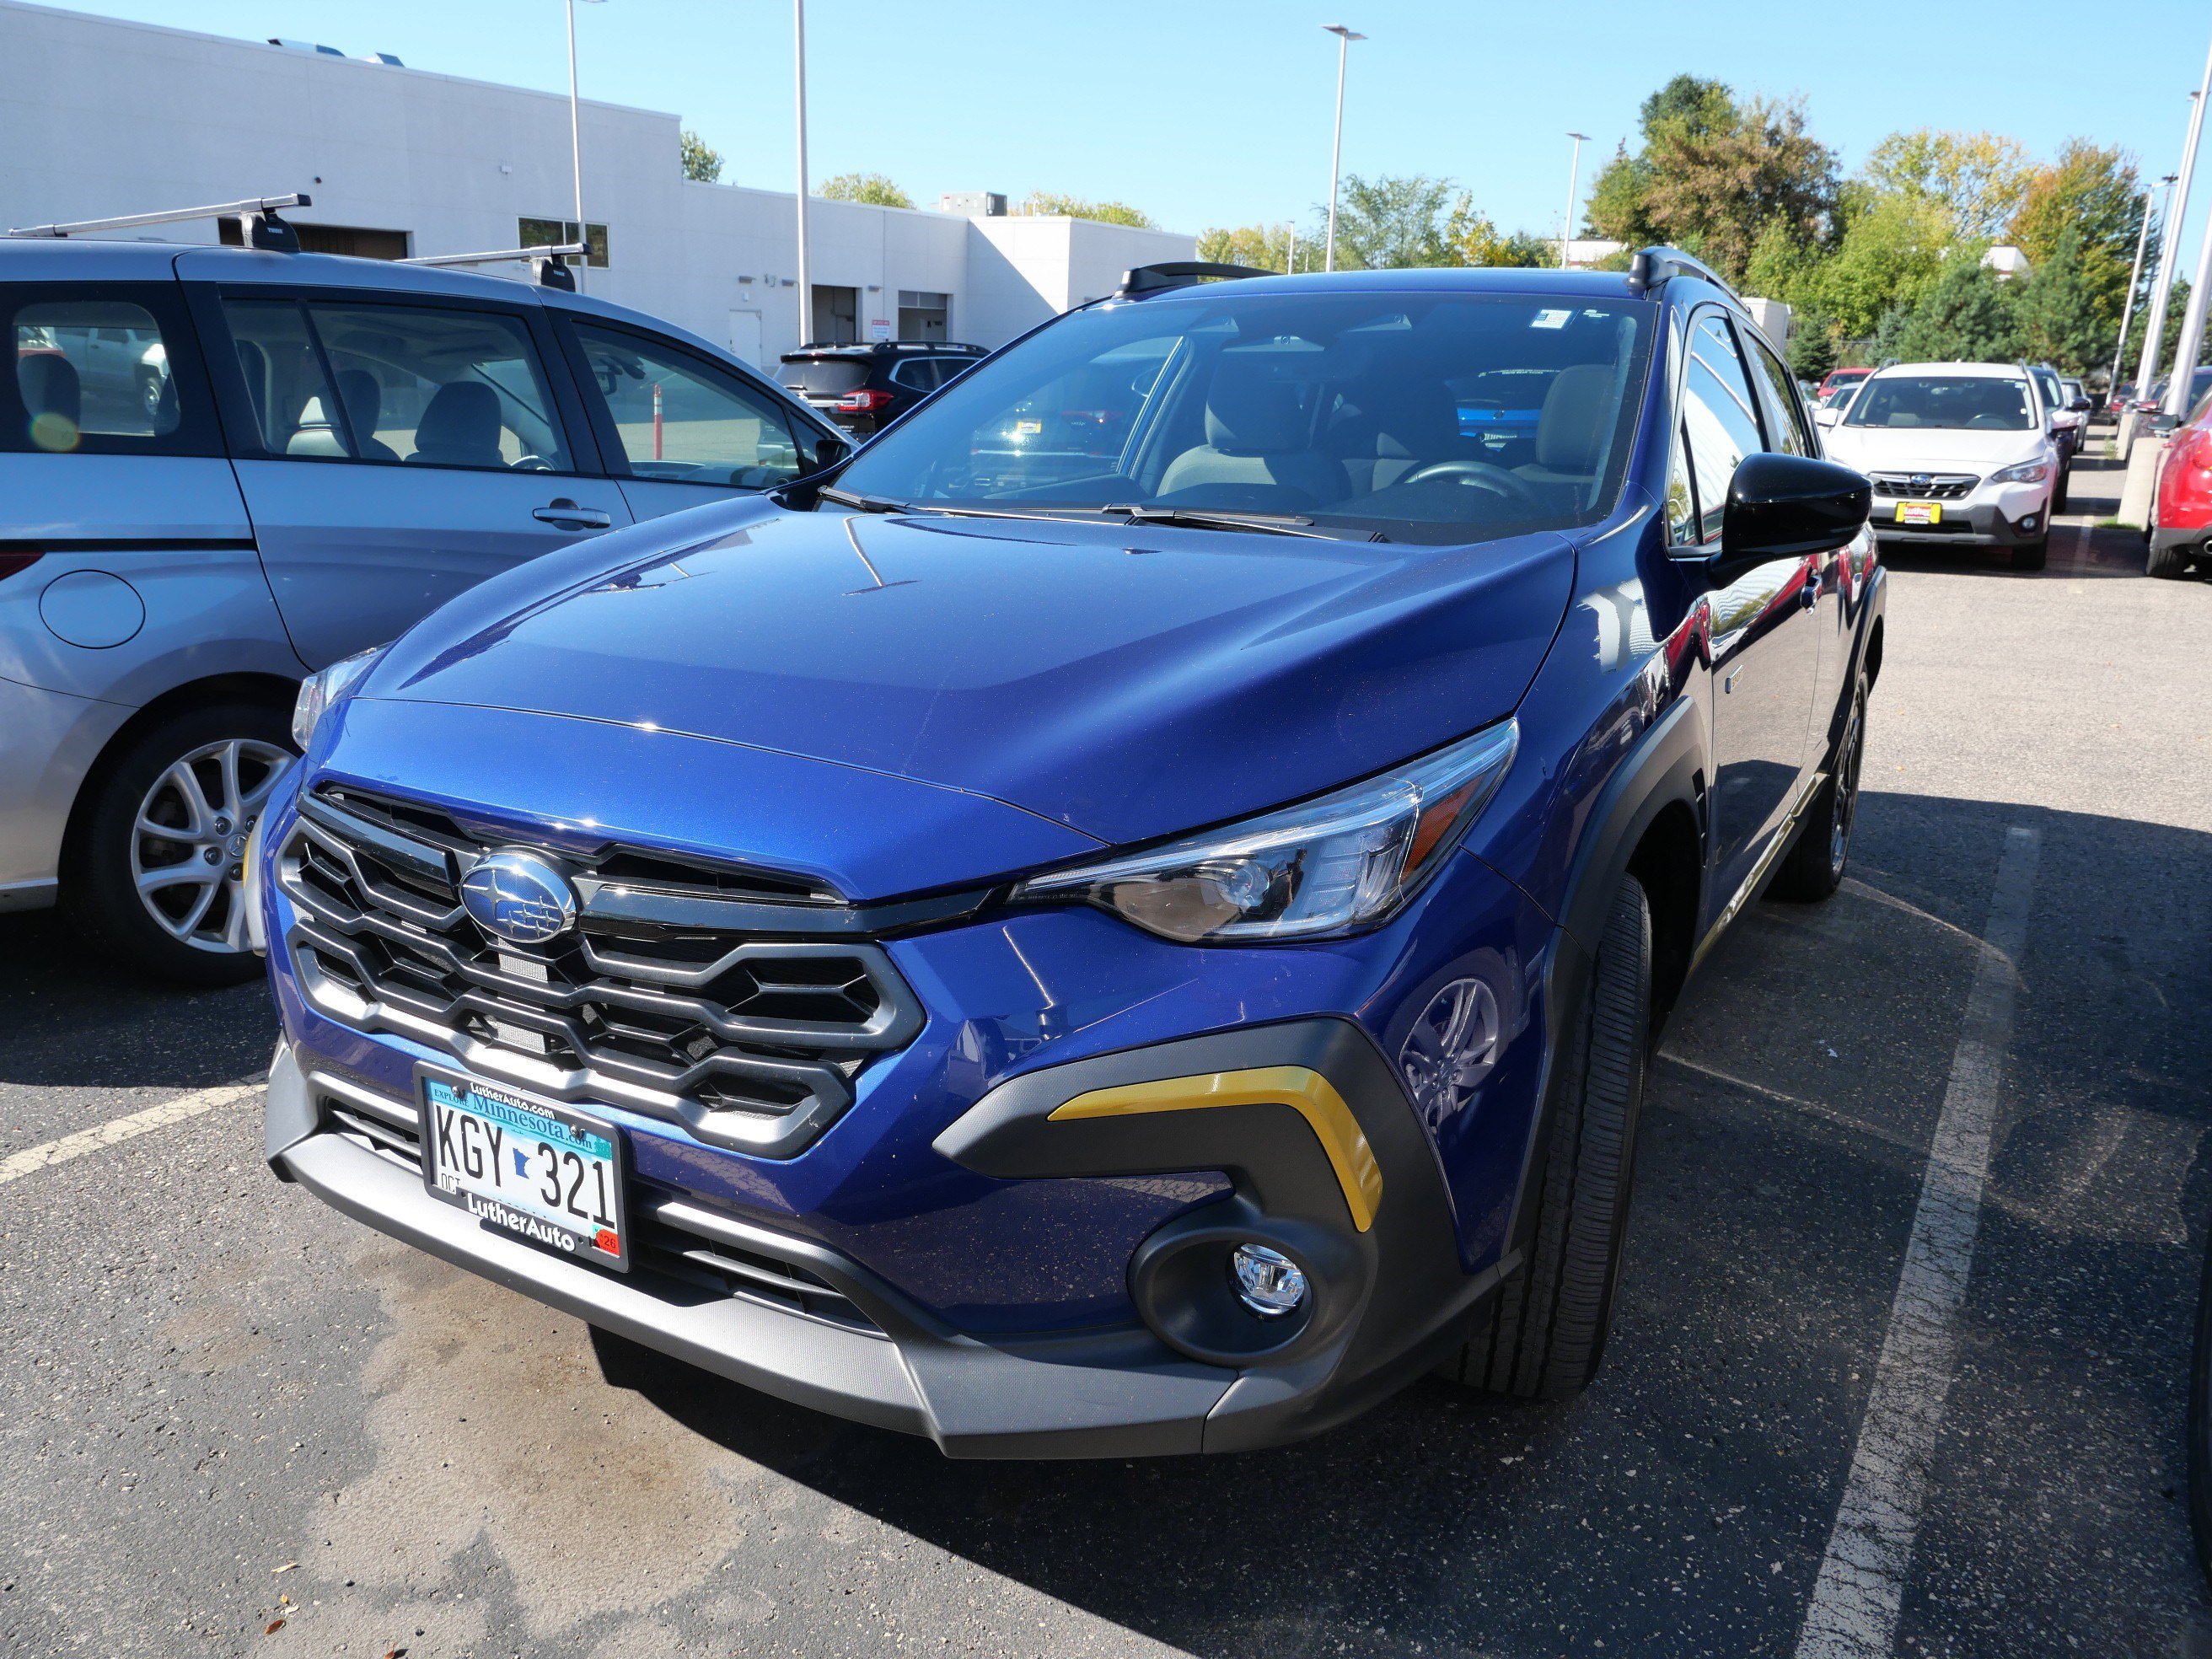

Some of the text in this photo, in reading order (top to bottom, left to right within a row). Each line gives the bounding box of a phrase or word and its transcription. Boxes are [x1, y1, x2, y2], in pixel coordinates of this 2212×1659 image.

[434, 1088, 470, 1108] EXPLORE
[470, 1082, 556, 1119] LutherAuto.com
[436, 1104, 615, 1230] KGY 321
[441, 1173, 461, 1193] OCT
[467, 1193, 576, 1253] LutherAuto
[604, 1235, 616, 1249] 26
